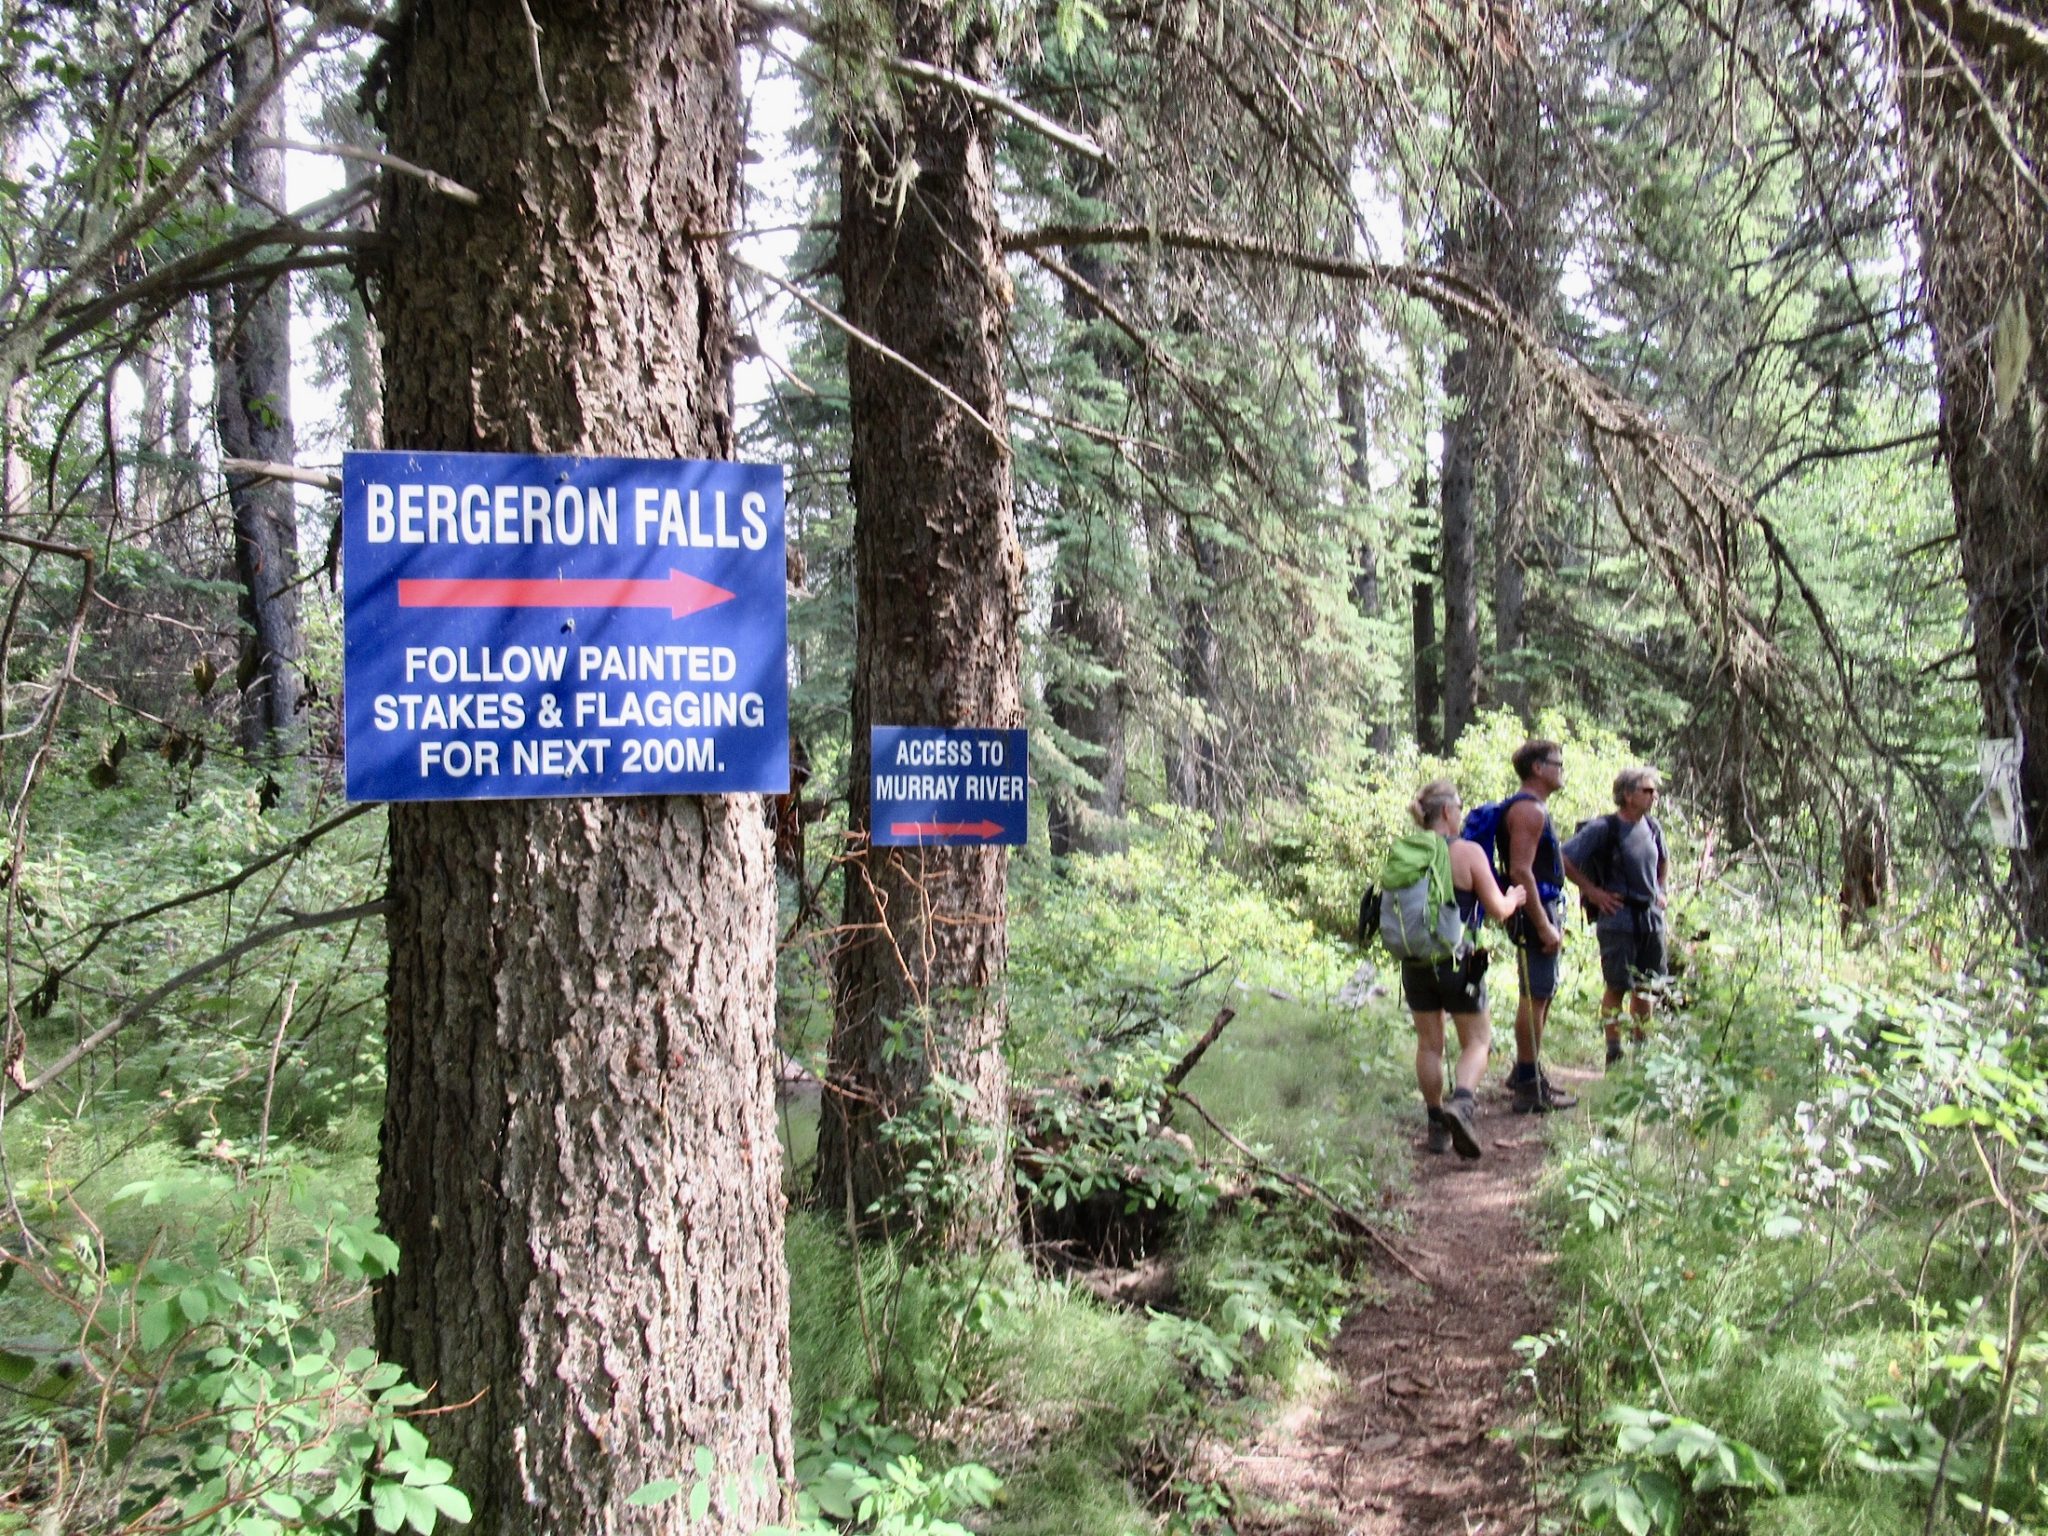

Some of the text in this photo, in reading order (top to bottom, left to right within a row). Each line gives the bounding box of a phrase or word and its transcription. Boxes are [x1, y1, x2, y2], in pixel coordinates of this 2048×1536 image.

[367, 484, 768, 550] BERGERON FALLS
[405, 646, 737, 682] FOLLOW PAINTED
[373, 691, 765, 731] STAKES & FLAGGING
[420, 737, 725, 777] FOR NEXT 200M.
[896, 739, 1004, 766] ACCESS TO
[876, 774, 1024, 801] MURRAY RIVER
